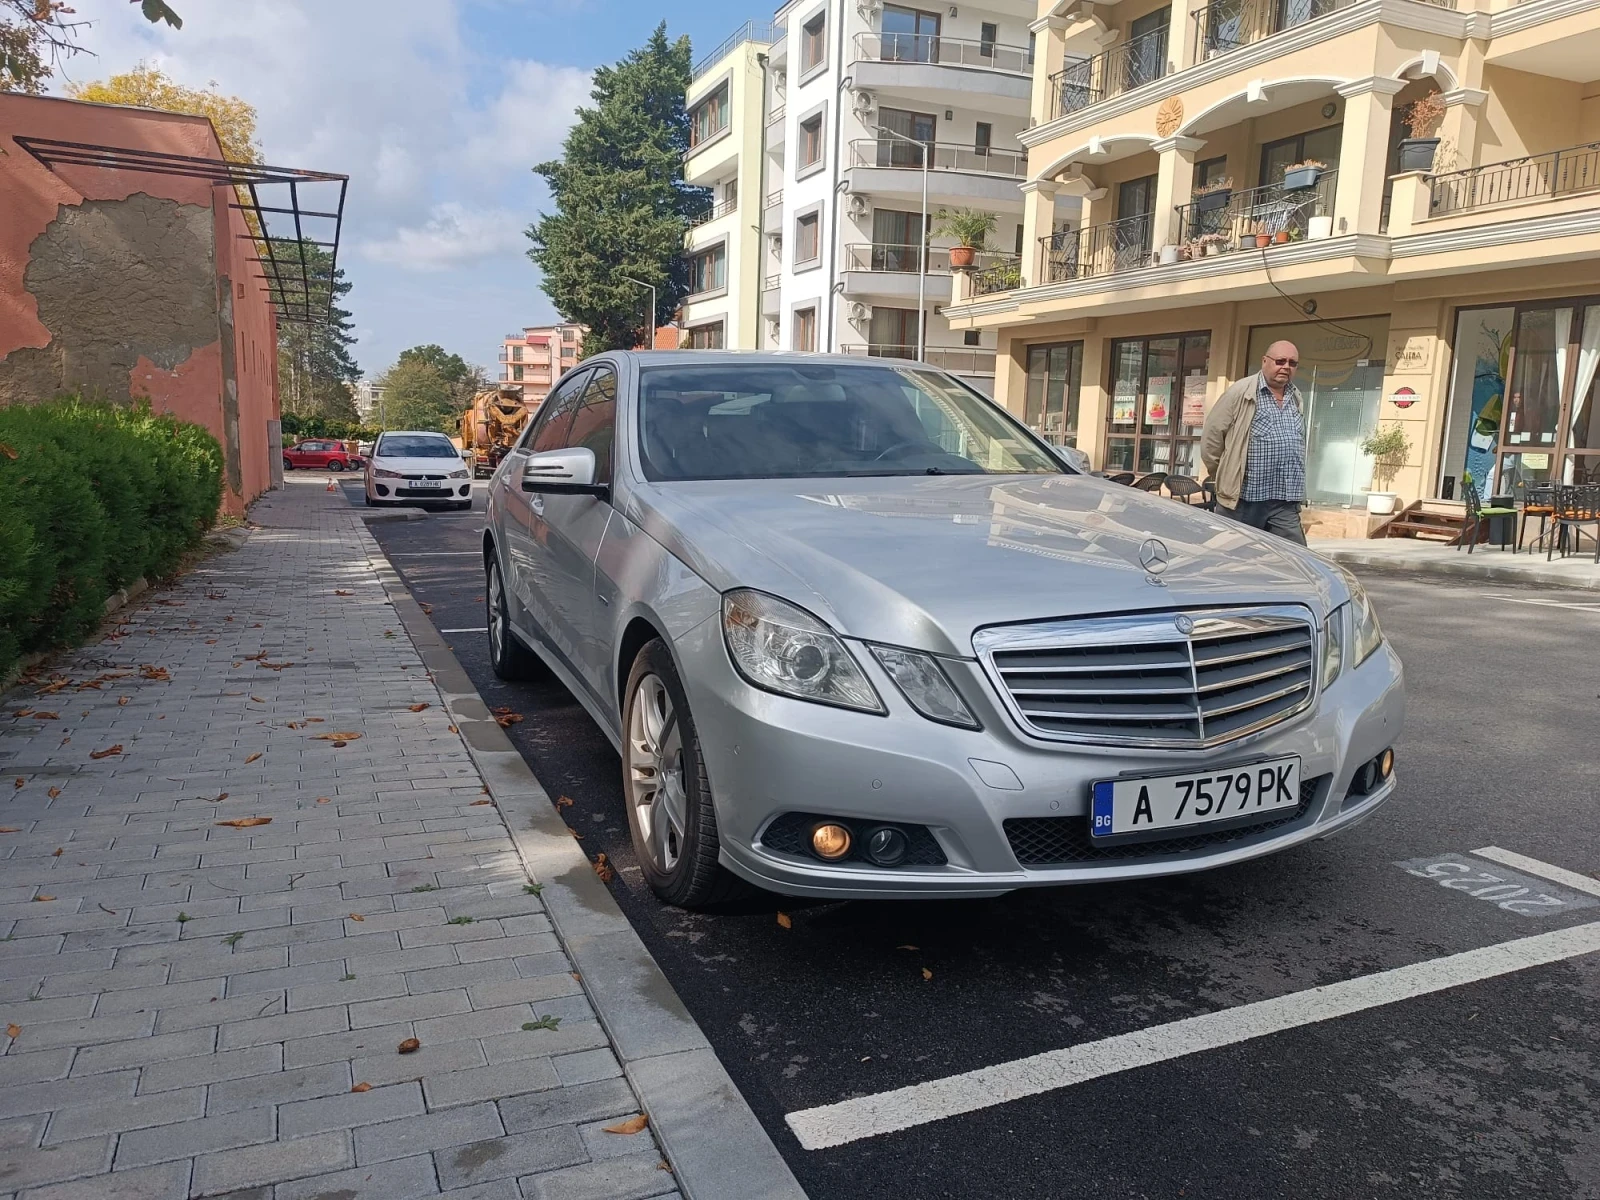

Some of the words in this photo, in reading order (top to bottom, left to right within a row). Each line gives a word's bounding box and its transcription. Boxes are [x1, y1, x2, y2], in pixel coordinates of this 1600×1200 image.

[1095, 815, 1111, 828] BG
[1132, 785, 1153, 825] A
[1405, 862, 1566, 913] 2025
